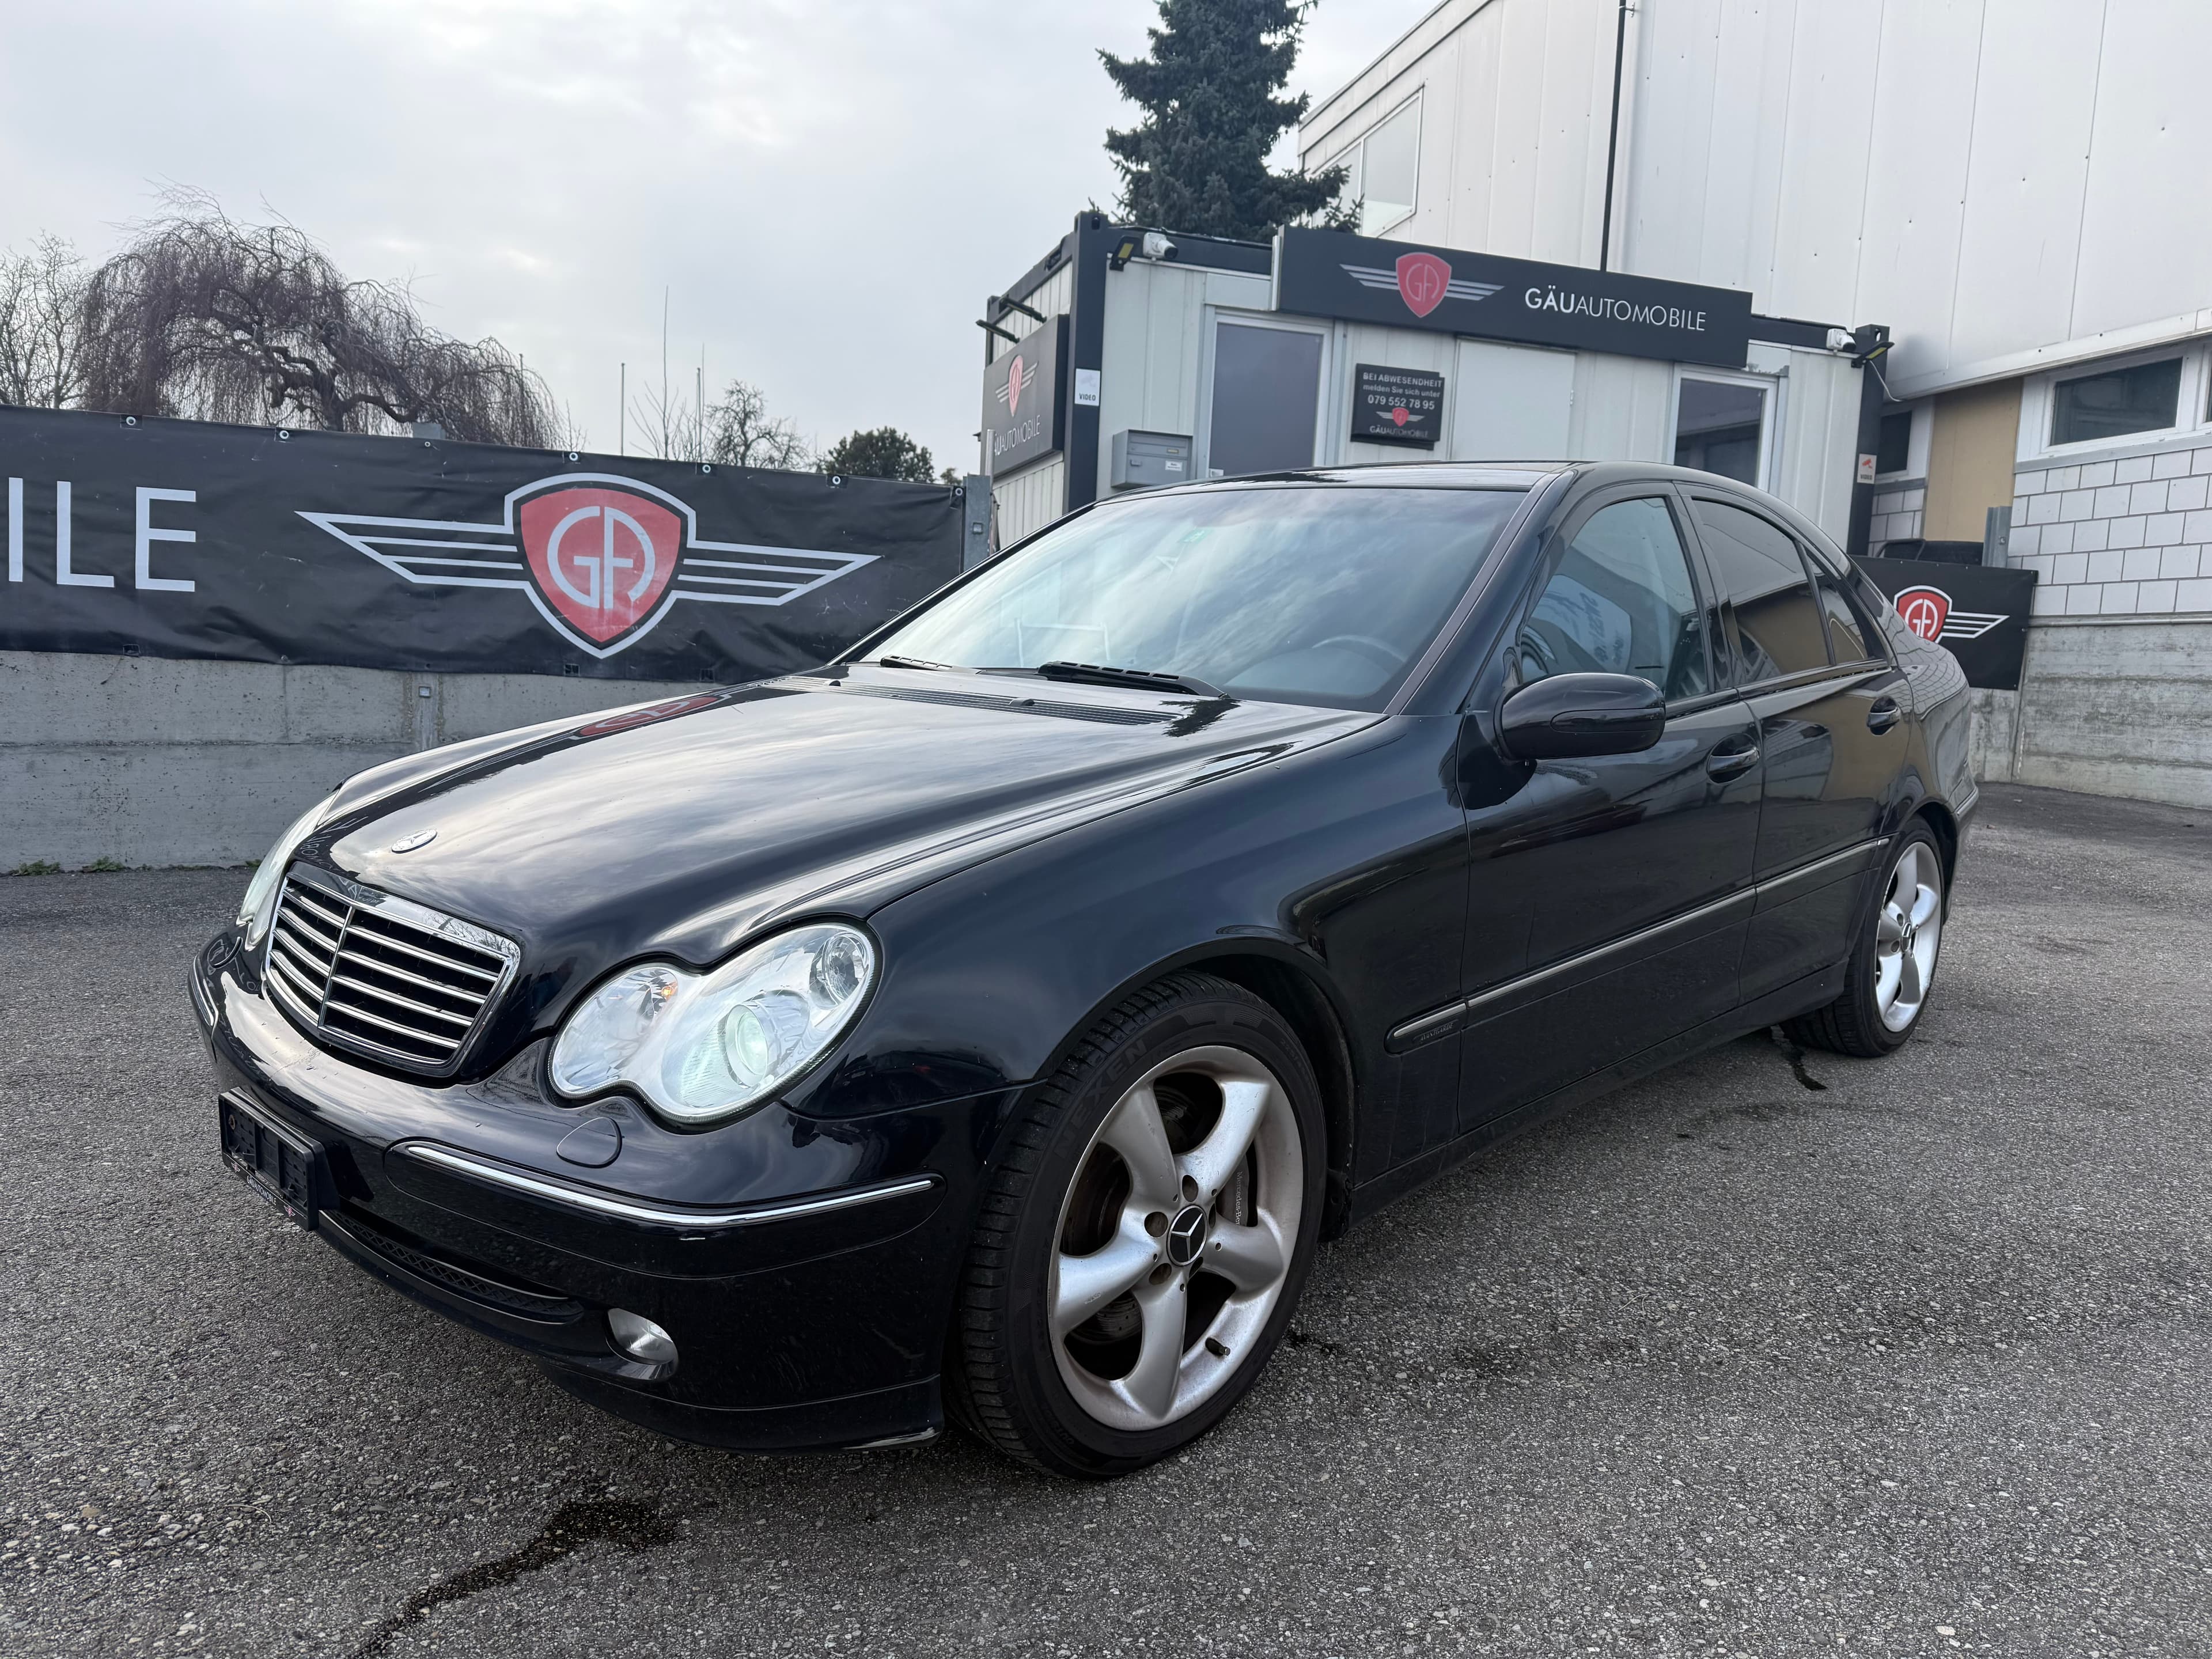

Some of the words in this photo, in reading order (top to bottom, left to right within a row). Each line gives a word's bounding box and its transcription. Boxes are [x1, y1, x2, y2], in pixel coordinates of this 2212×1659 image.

[1525, 285, 1707, 331] GÄUAUTOMOBILE
[1363, 372, 1377, 381] BEI
[1378, 374, 1442, 387] ABWESENDHEIT
[1079, 392, 1096, 402] VIDEO
[1363, 384, 1391, 393] melden
[1391, 386, 1404, 394] Sie
[1404, 388, 1421, 396] sich
[1421, 390, 1440, 398] unter
[1368, 395, 1387, 405] 079
[1388, 397, 1407, 407] 552
[1409, 399, 1421, 408] 78
[1422, 400, 1435, 410] 95
